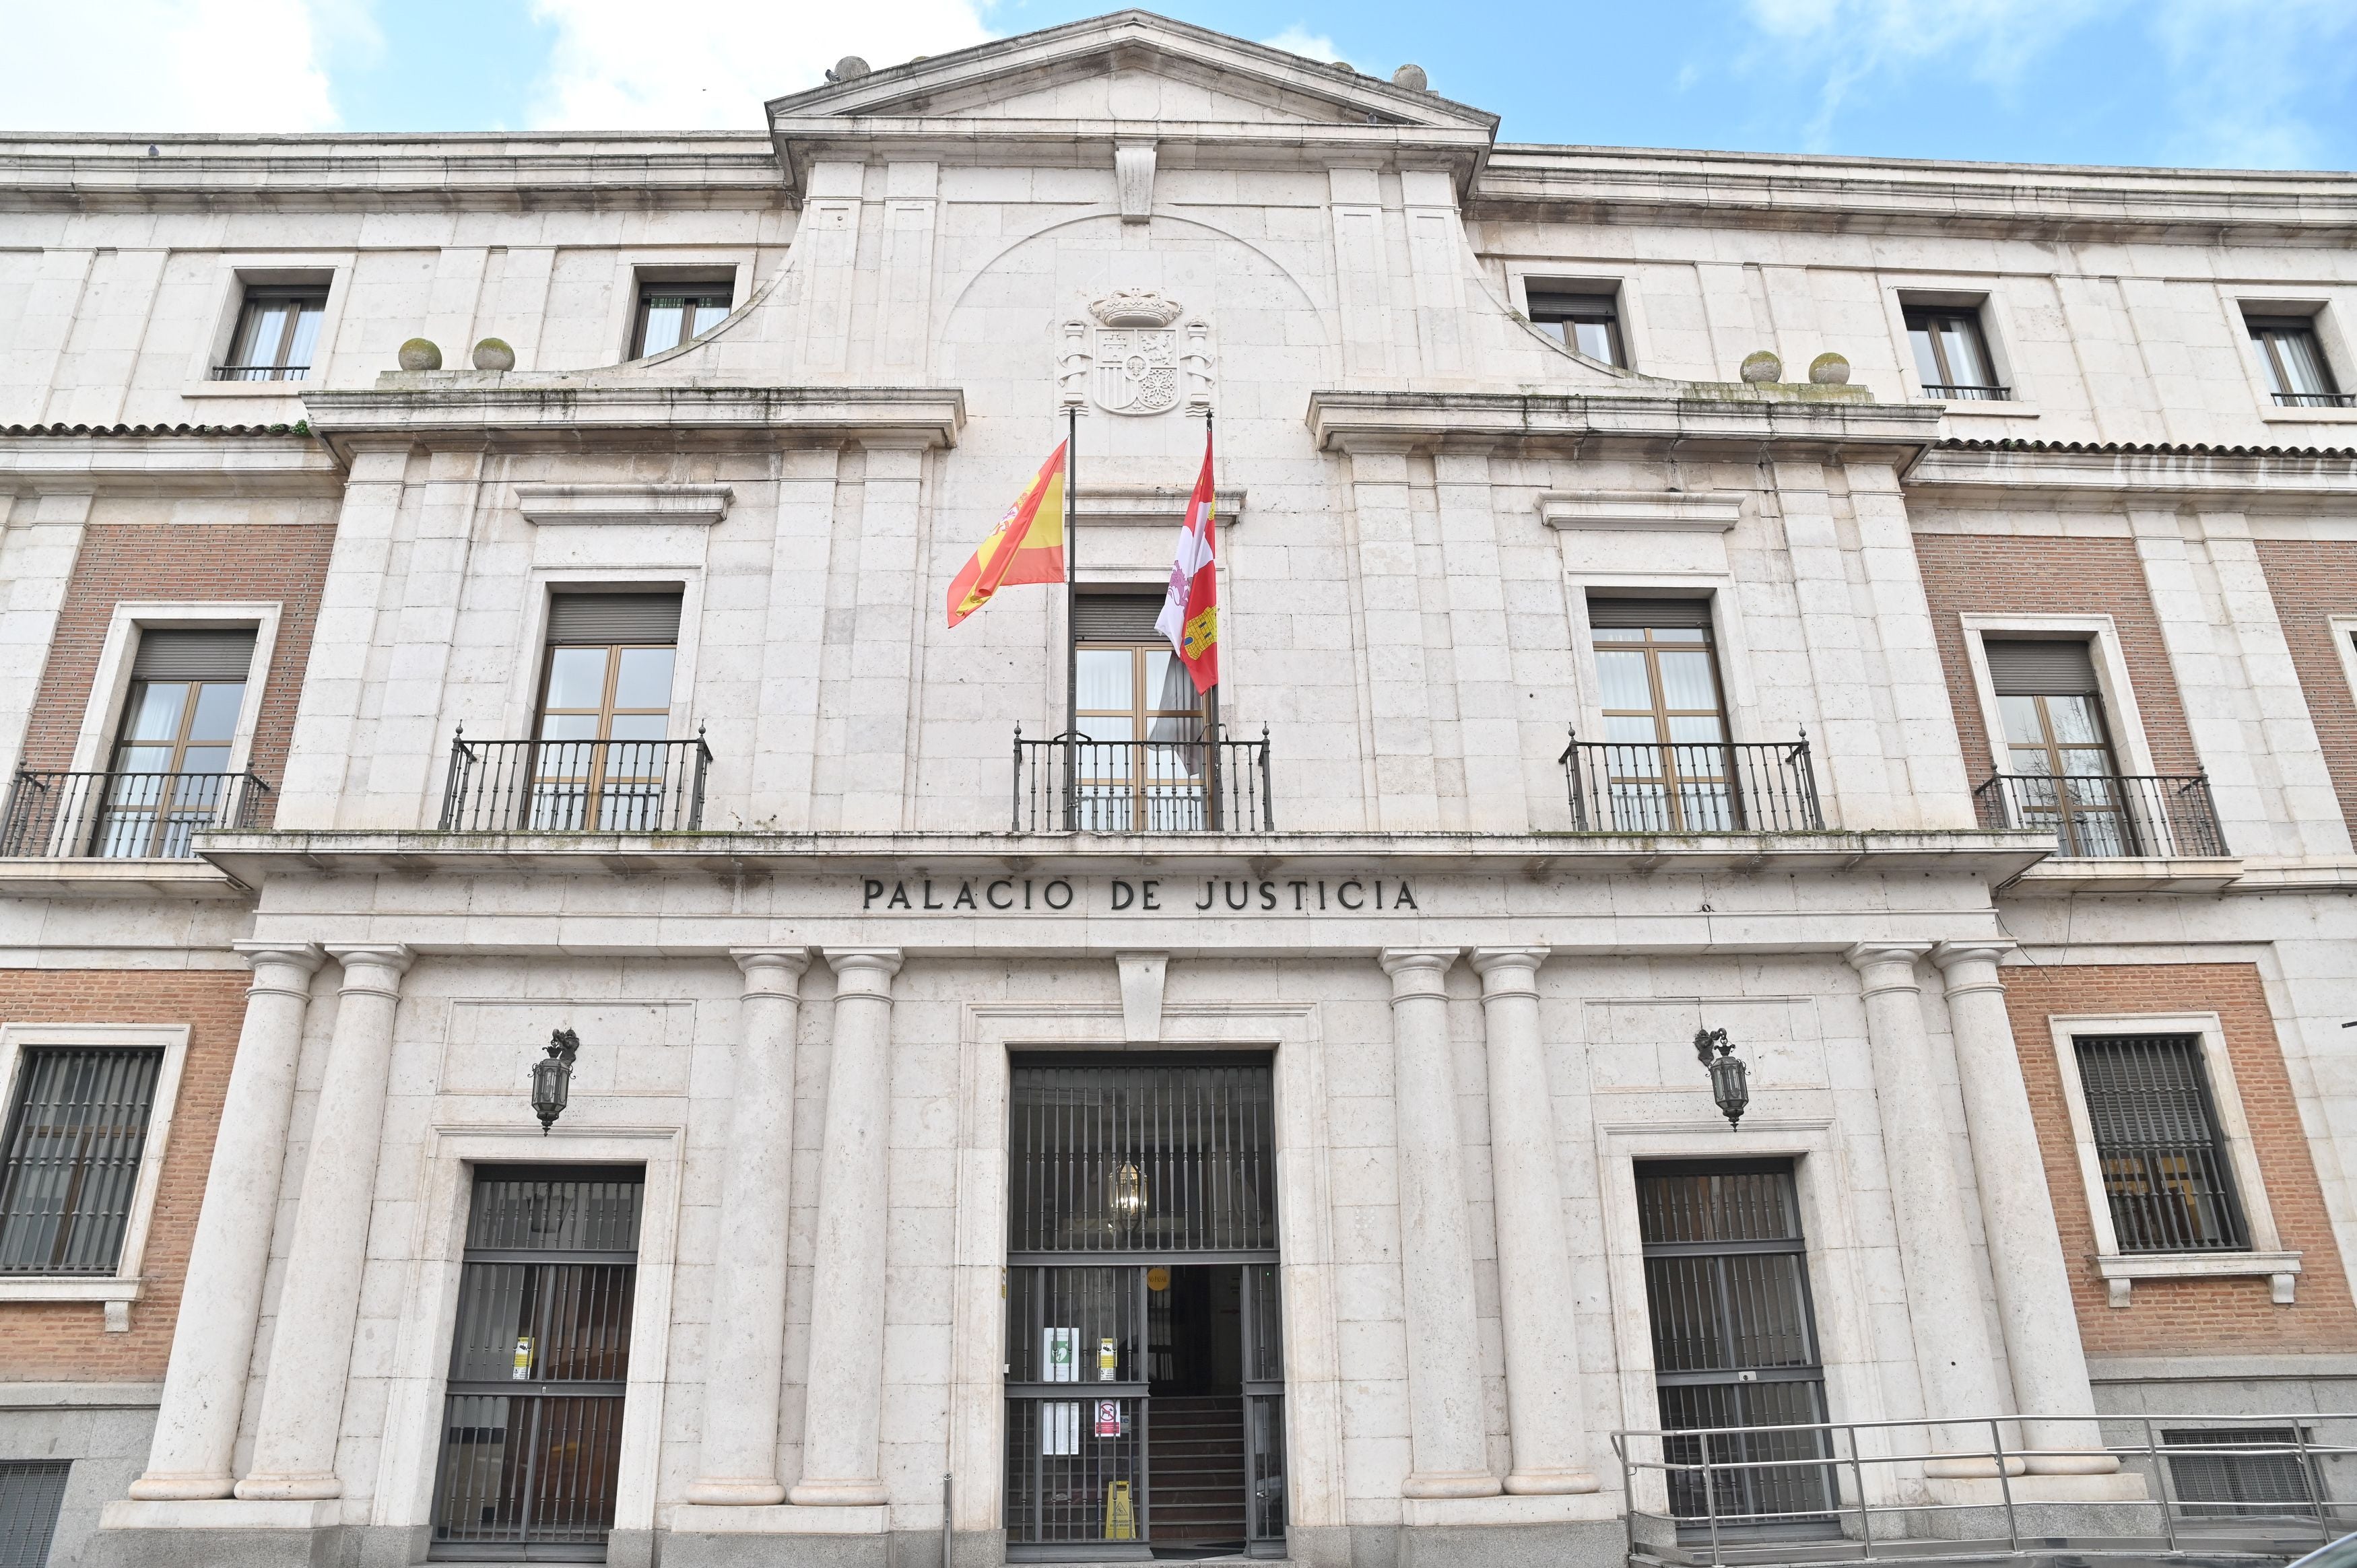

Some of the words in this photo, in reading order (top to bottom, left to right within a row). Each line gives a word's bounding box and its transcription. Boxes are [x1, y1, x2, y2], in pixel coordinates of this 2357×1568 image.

[863, 880, 1073, 910] PALACIO
[1111, 881, 1160, 910] DE
[1195, 881, 1418, 910] JUSTICIA
